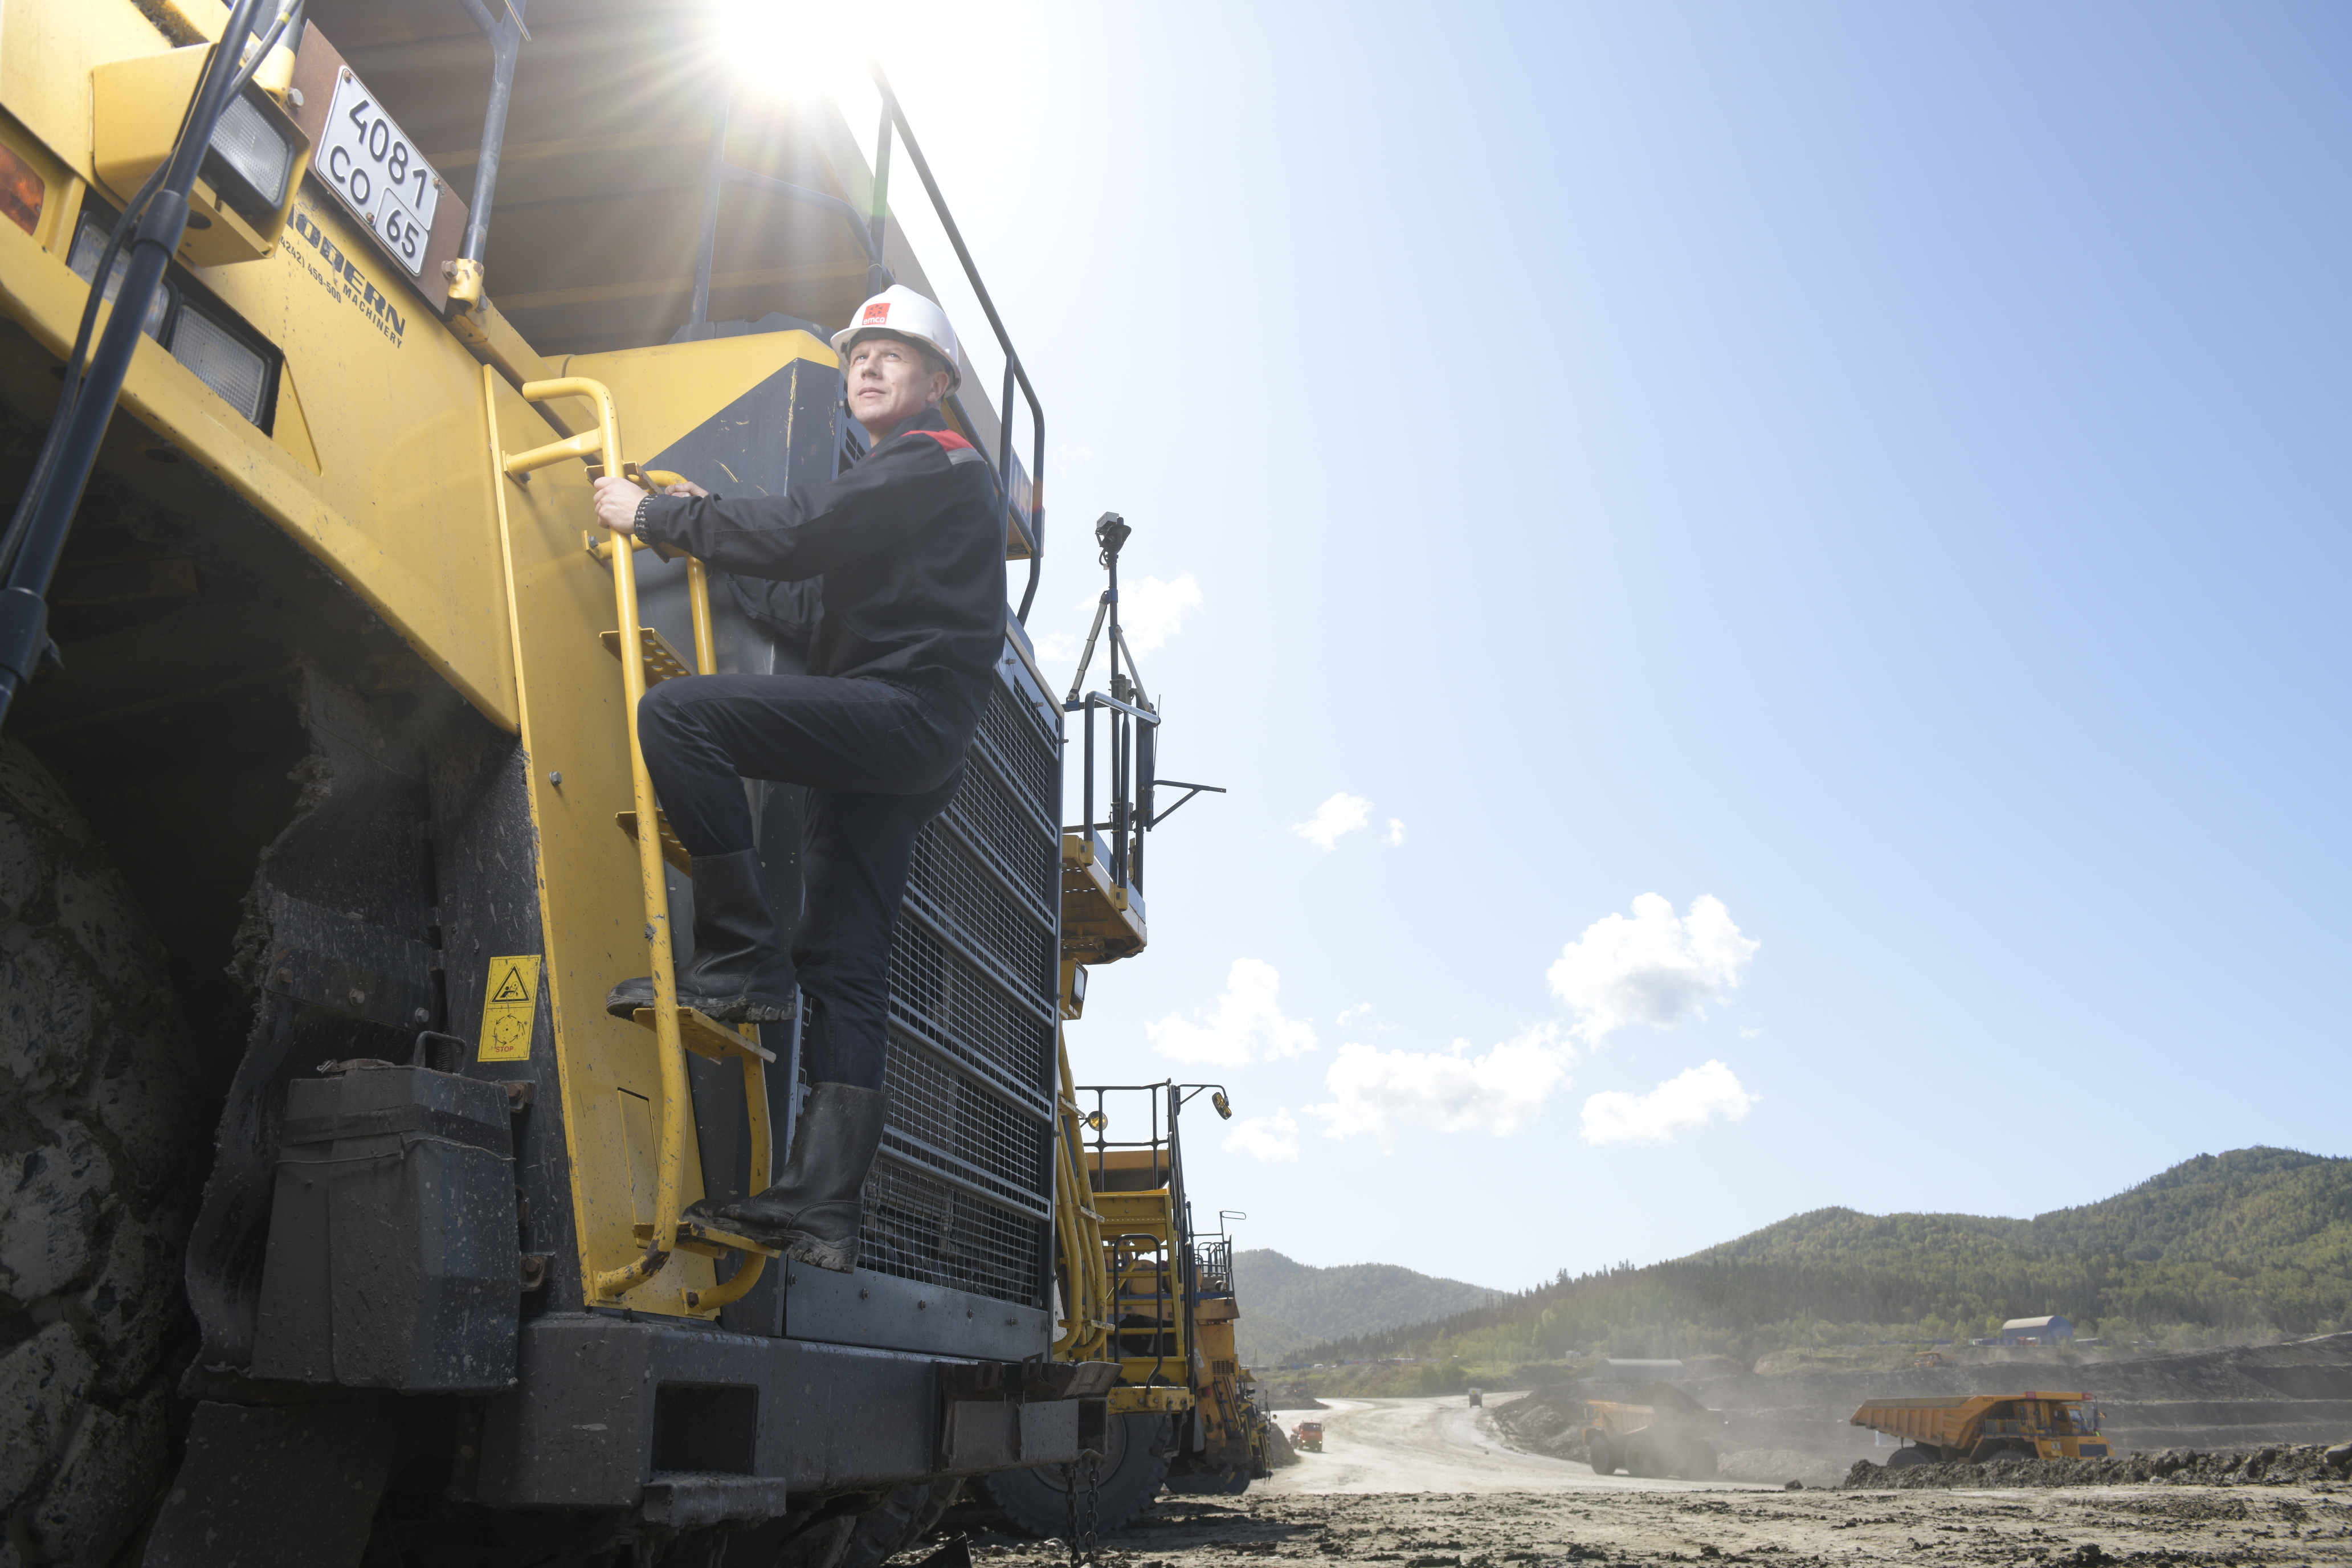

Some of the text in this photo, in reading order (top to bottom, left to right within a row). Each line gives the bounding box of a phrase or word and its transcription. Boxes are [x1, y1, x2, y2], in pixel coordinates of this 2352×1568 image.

[349, 100, 427, 209] 4081
[329, 145, 419, 258] CO 65
[308, 263, 341, 304] 459-500
[342, 283, 402, 349] MACHINERY
